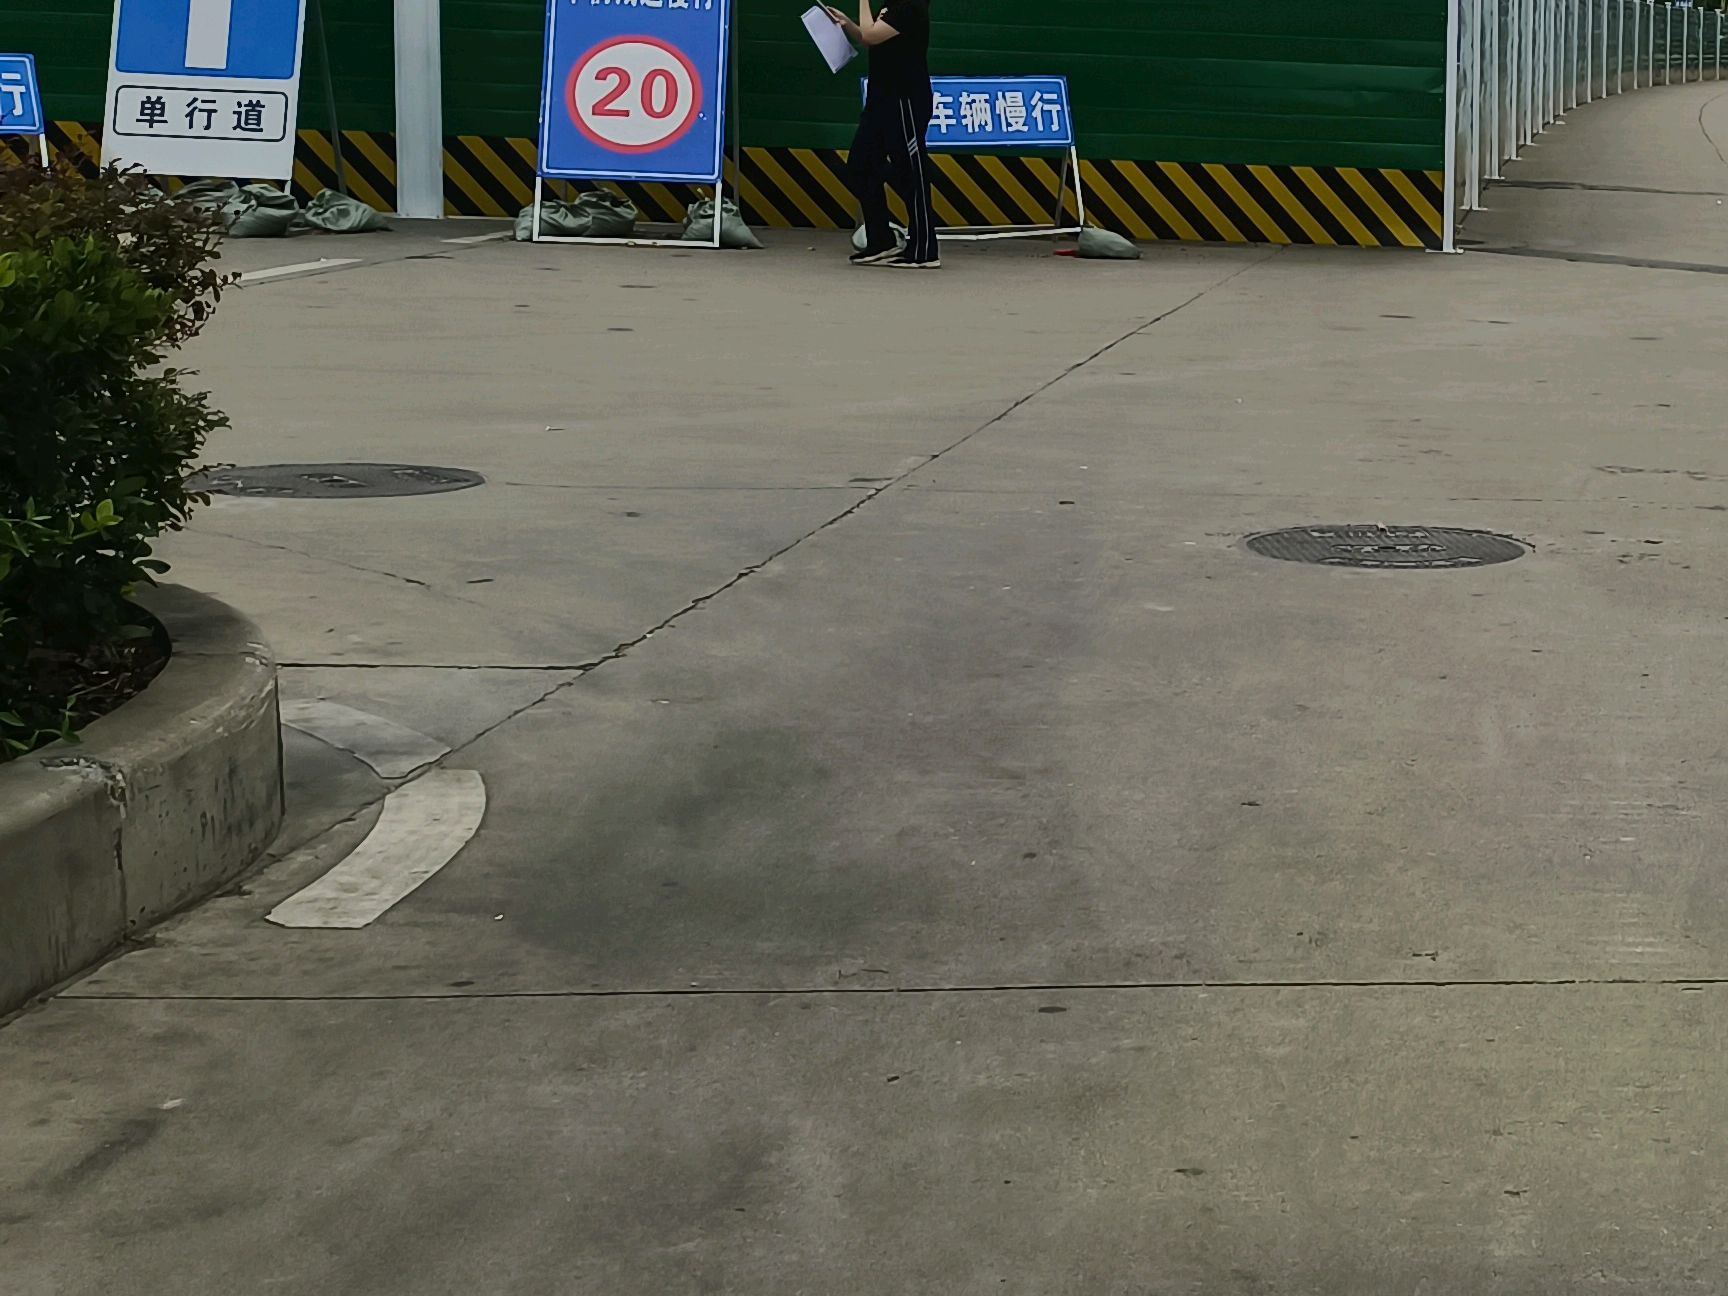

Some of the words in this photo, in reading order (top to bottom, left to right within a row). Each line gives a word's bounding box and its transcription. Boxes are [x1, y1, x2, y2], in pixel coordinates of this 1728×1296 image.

[136, 95, 265, 133] 单行道
[591, 66, 678, 119] 20
